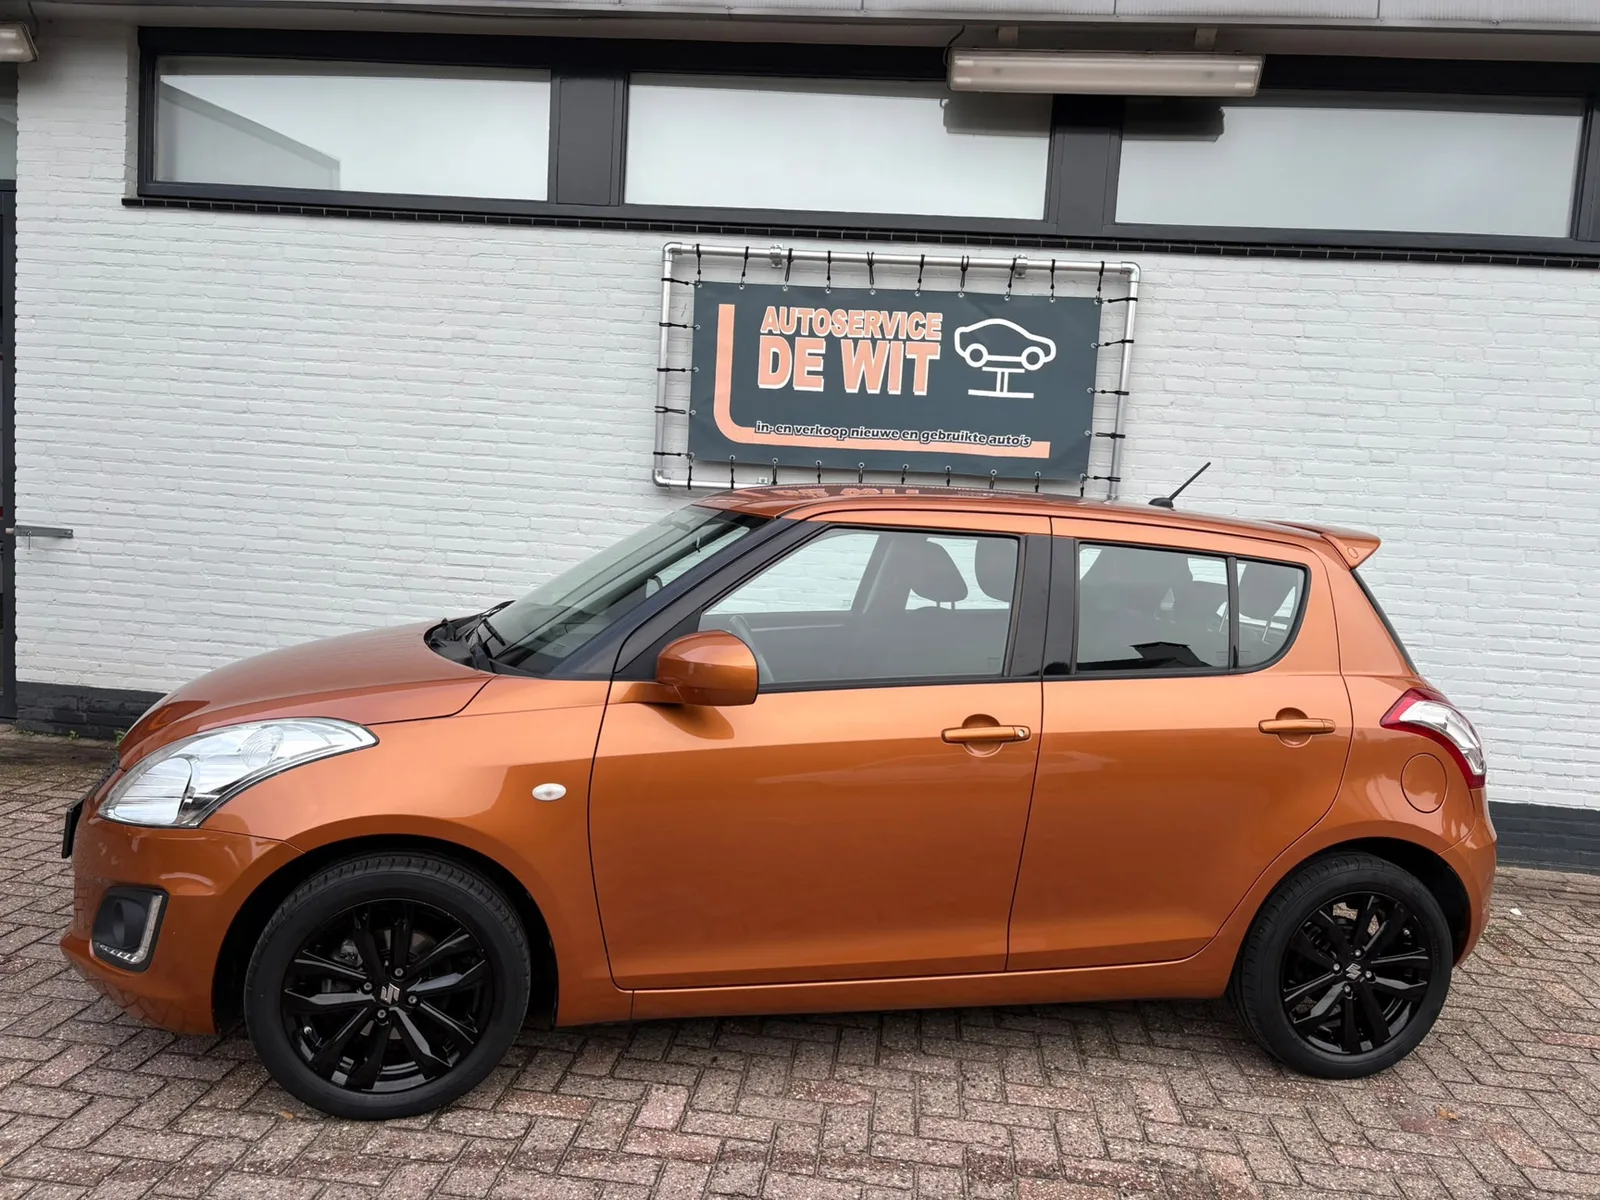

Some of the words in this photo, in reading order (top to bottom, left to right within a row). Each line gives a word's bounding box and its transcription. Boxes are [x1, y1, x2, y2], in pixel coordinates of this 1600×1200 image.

[760, 306, 943, 340] AUTOSERVICE
[758, 335, 826, 392] DE
[840, 339, 941, 396] WIT
[775, 423, 792, 434] en
[795, 424, 848, 440] verkoop
[850, 426, 900, 440] nieuwe
[901, 429, 919, 440] en
[920, 429, 986, 444] gebruikte
[988, 434, 1031, 446] auto's
